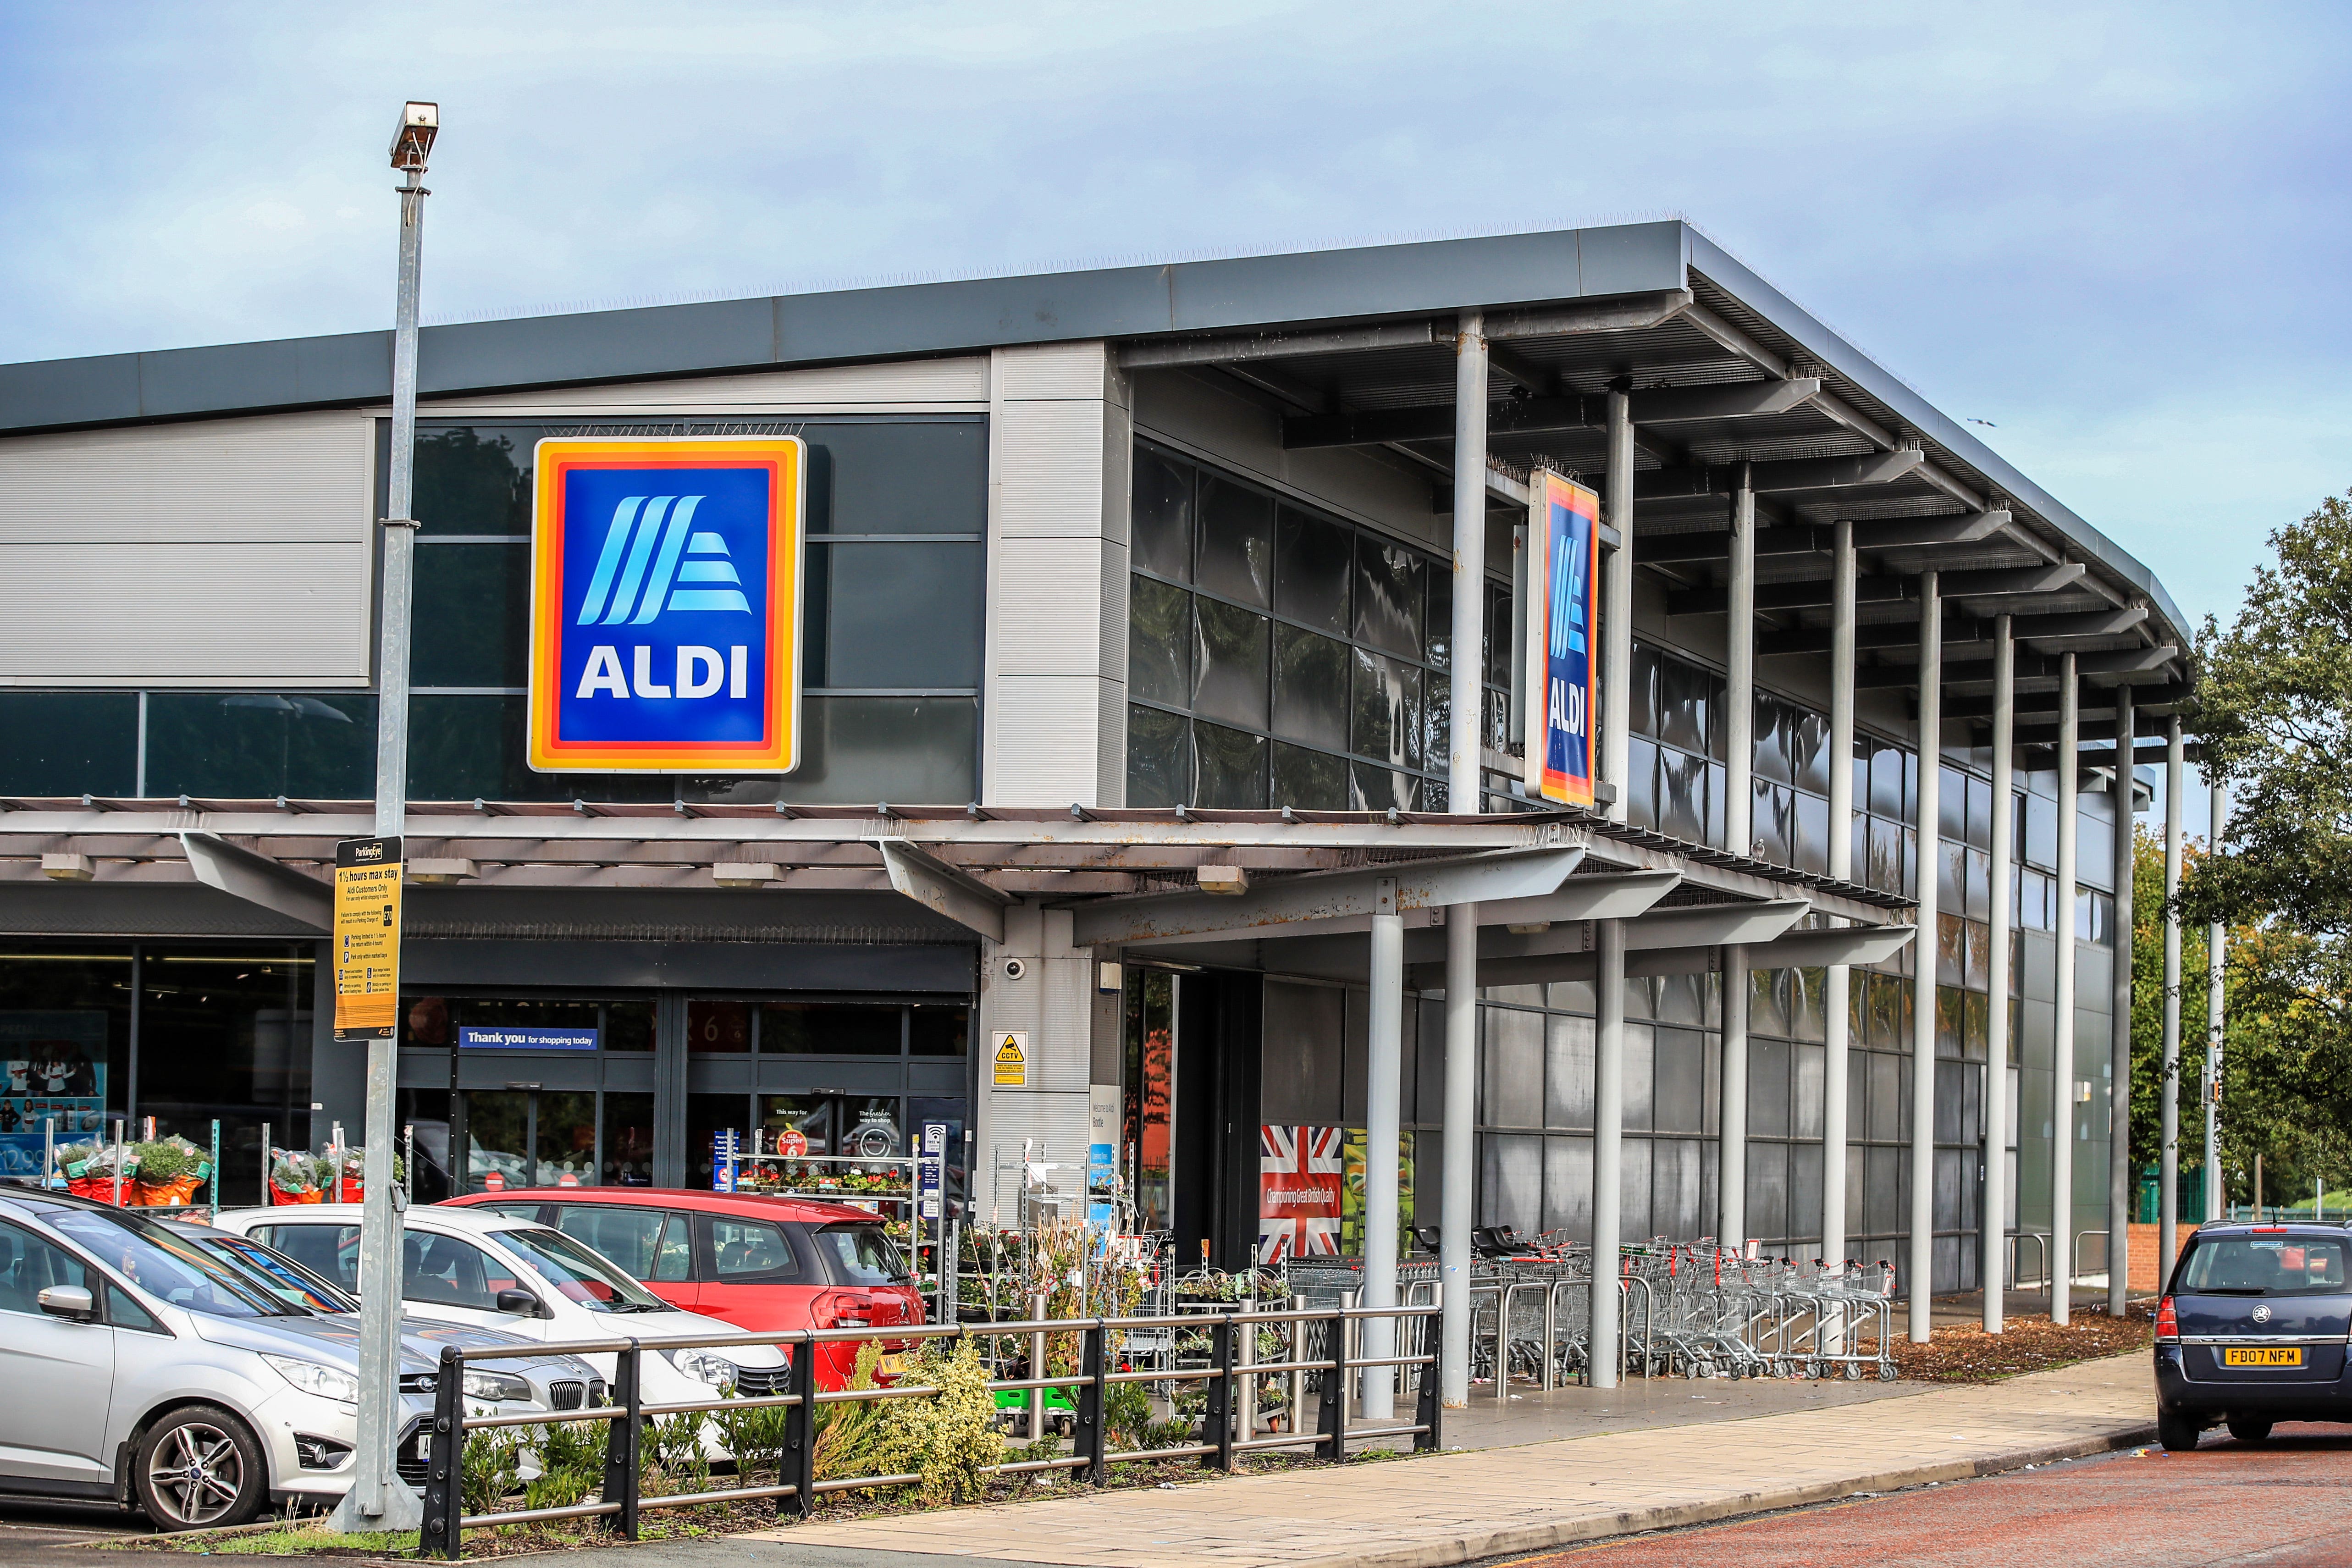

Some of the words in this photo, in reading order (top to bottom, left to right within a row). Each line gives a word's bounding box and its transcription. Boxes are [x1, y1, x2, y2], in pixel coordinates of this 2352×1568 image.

[575, 645, 748, 699] ALDI
[1548, 677, 1585, 737] ALDI
[356, 846, 381, 858] ParkingEye
[350, 871, 367, 881] hours
[369, 871, 382, 880] max
[384, 868, 398, 880] stay
[356, 885, 377, 894] Customers
[378, 884, 387, 893] Only
[384, 911, 392, 921] £70
[468, 1032, 503, 1043] Thank
[504, 1034, 526, 1045] you
[539, 1036, 572, 1046] shopping
[573, 1037, 593, 1046] today
[869, 1109, 891, 1117] fresher
[1093, 1103, 1105, 1112] Welcome
[1093, 1116, 1104, 1127] Bootle
[782, 1137, 803, 1146] Super
[787, 1145, 797, 1155] 6
[0, 1149, 45, 1170] 12.99
[1267, 1187, 1296, 1208] Championing
[1297, 1188, 1308, 1204] Great
[1308, 1187, 1320, 1203] British
[1321, 1187, 1335, 1207] Quality
[2231, 1350, 2265, 1363] FD07
[2269, 1350, 2295, 1363] NFM
[884, 1357, 897, 1370] MK17
